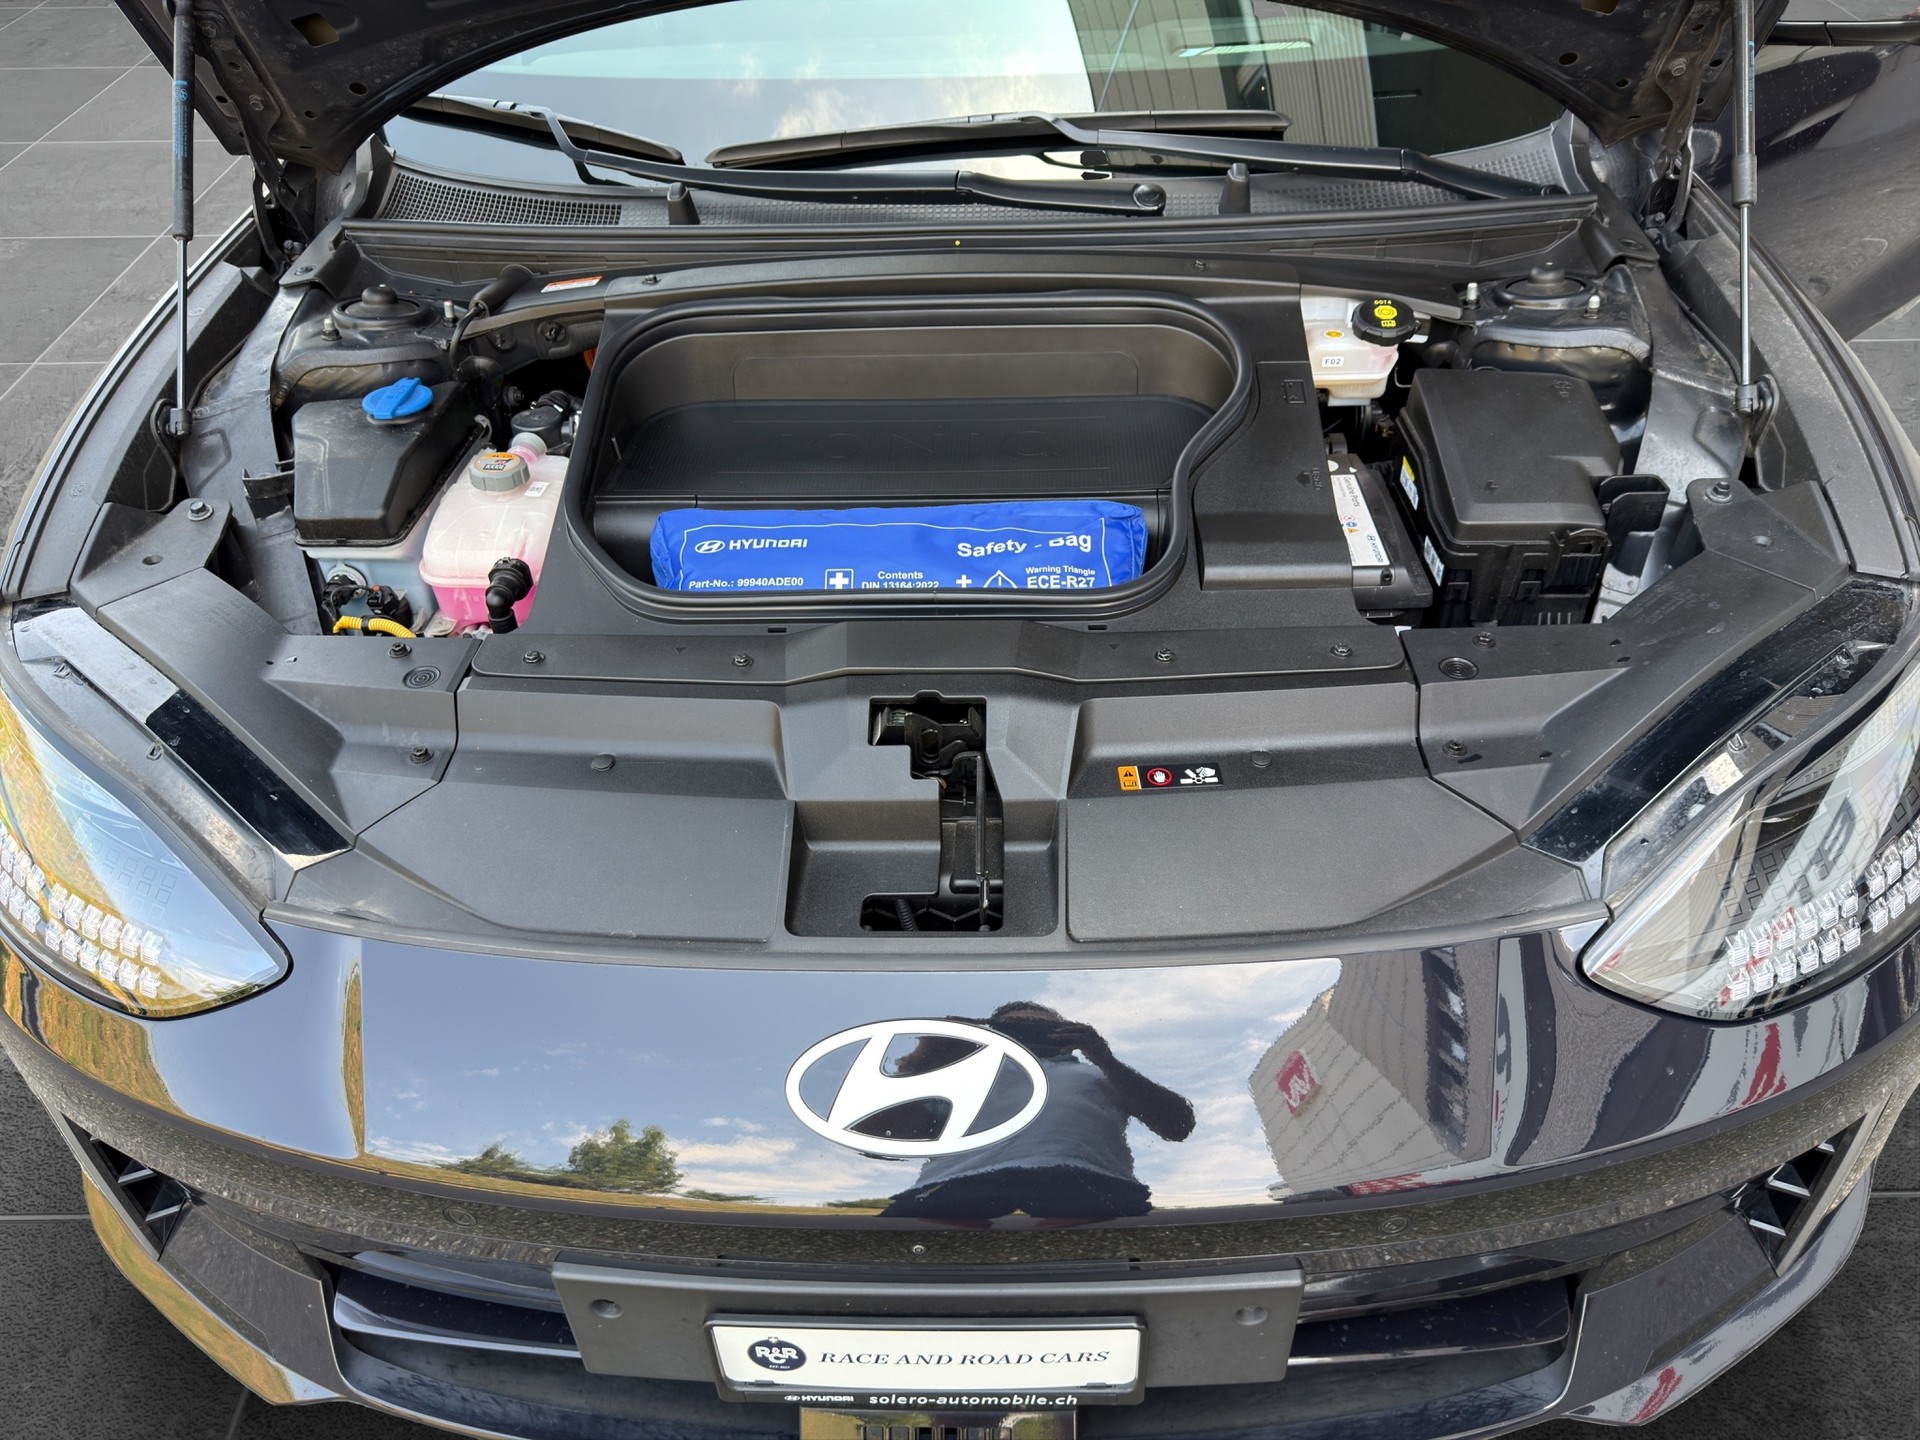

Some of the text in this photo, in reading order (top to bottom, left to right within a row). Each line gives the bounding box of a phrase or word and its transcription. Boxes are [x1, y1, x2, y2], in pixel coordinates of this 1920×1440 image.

[729, 538, 808, 551] HYUNDAI
[956, 538, 1028, 558] Safety
[877, 570, 924, 580] Contents
[1025, 565, 1096, 576] Warning Triangle
[688, 577, 804, 589] Part-No.: 99940ADE00
[1026, 575, 1096, 589] ECE-R27
[819, 1350, 1111, 1365] RACE AND ROAD CARS
[869, 1394, 1078, 1406] solero-automobile.ch
